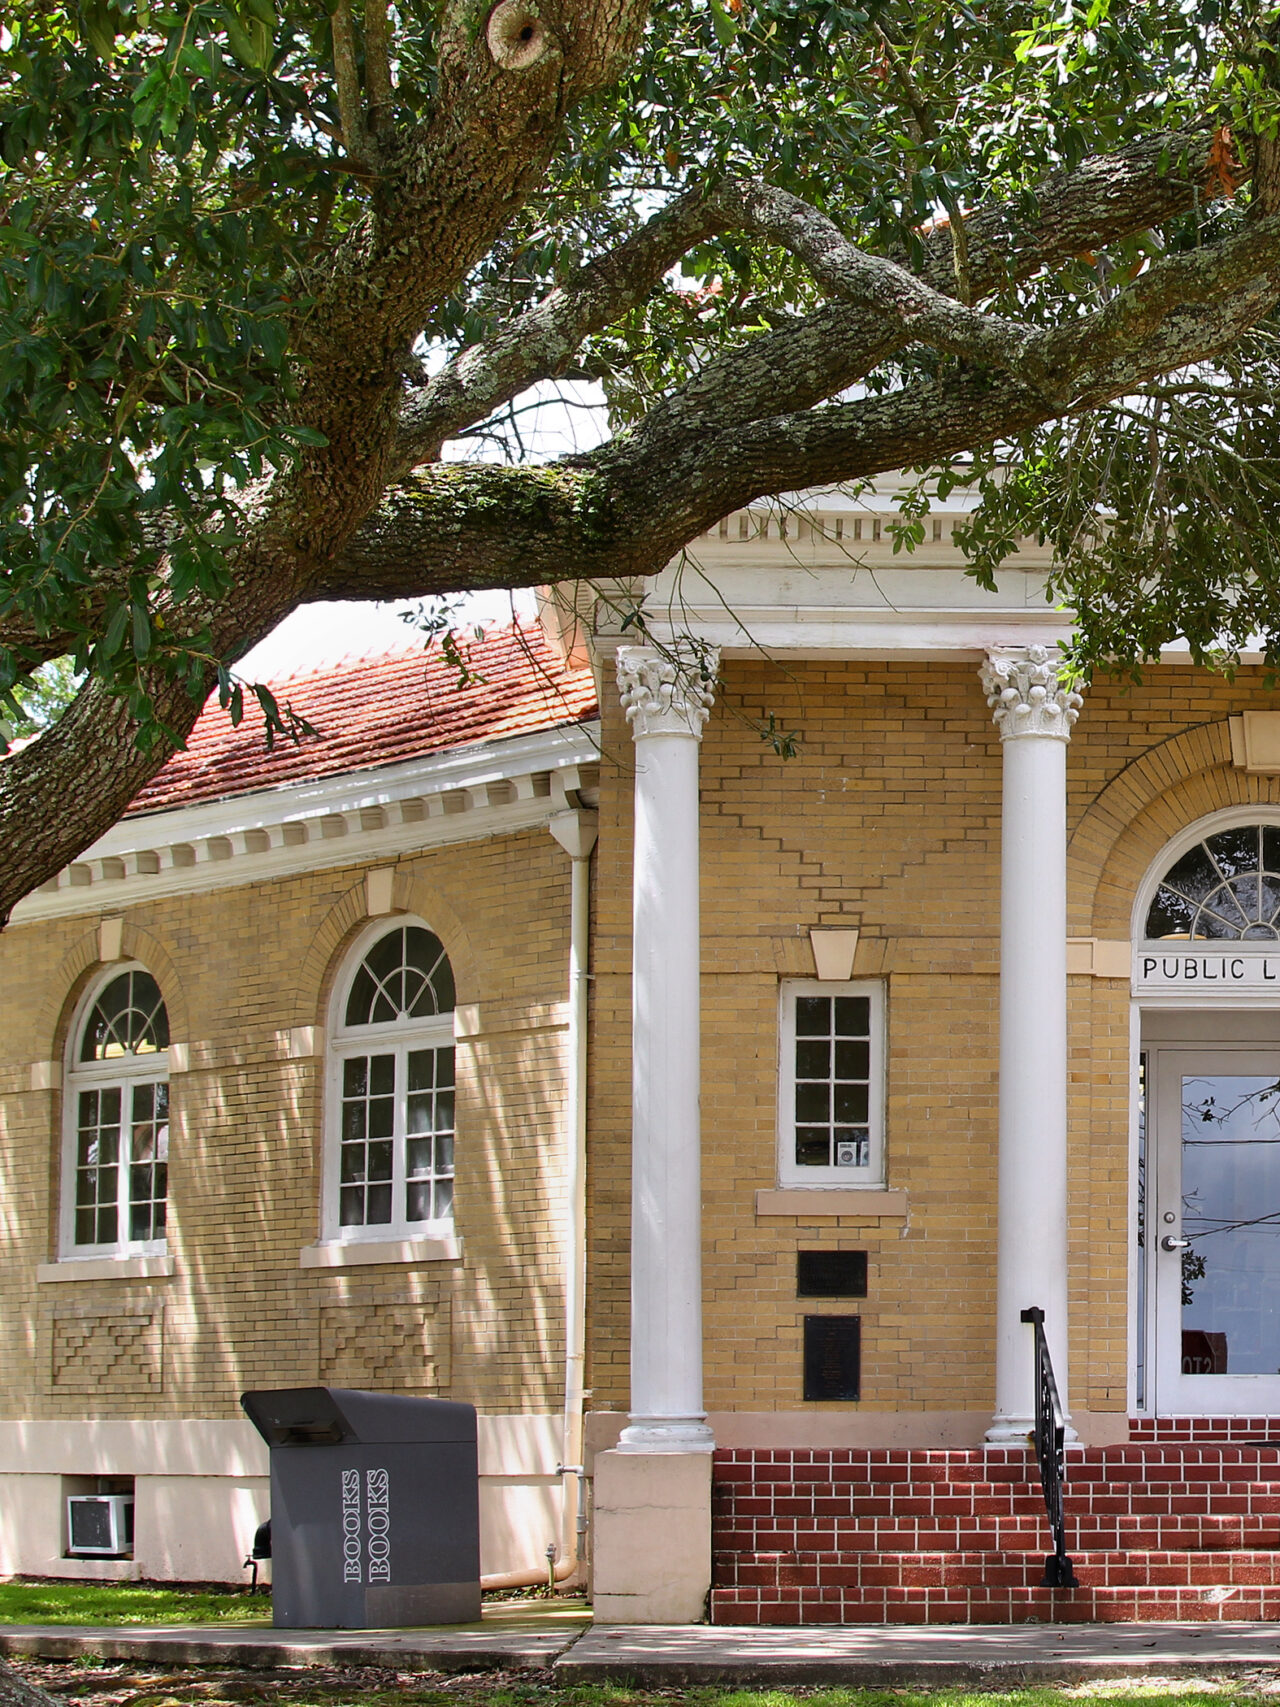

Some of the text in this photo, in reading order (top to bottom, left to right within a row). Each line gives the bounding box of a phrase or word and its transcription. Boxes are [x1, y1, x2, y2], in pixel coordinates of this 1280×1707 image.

[1144, 958, 1244, 979] PUBLIC
[343, 1469, 361, 1583] BOOKS
[366, 1468, 390, 1583] BOOKS
